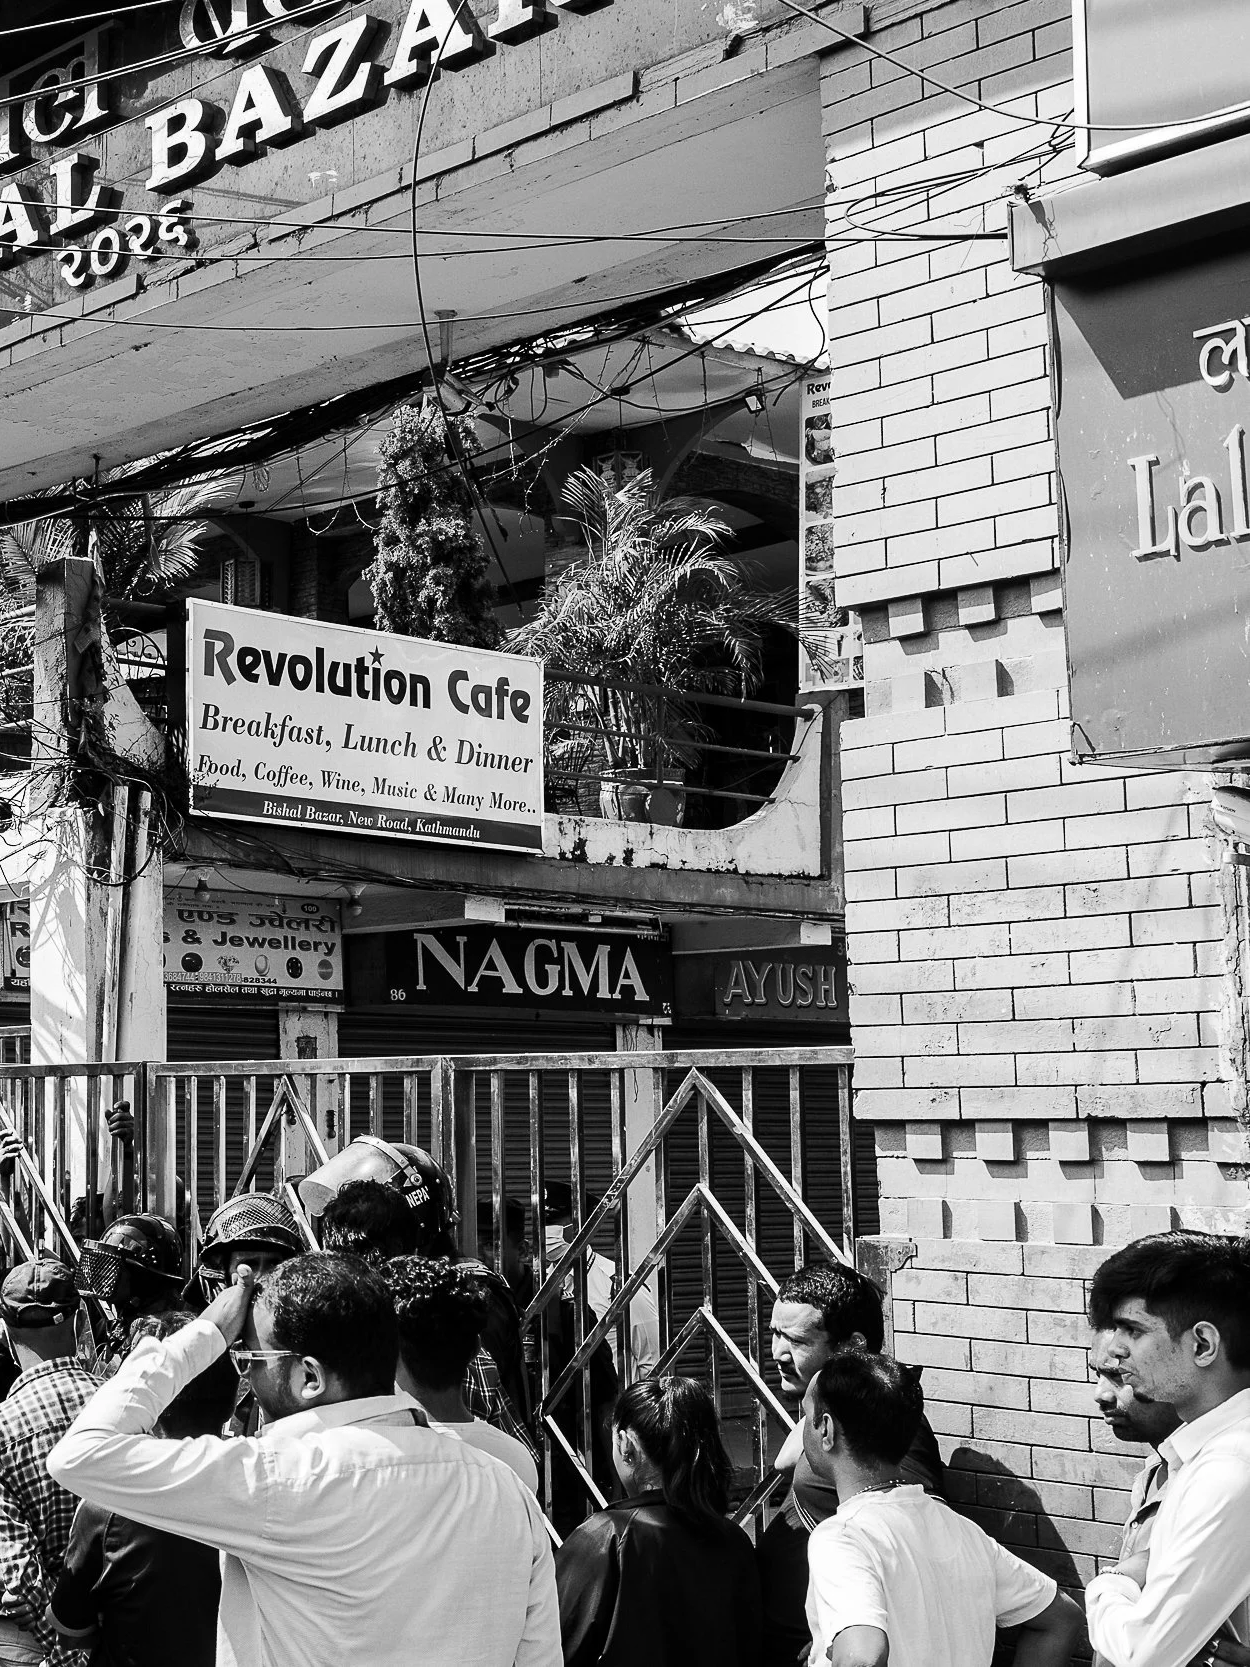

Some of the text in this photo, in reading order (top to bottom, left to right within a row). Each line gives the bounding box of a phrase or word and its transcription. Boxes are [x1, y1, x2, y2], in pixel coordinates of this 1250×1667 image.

[203, 628, 532, 724] Revolution Cafe
[199, 703, 534, 774] Breakfast, Lunch & Dinner
[197, 754, 247, 782] Food,
[254, 762, 314, 791] Coffee,
[321, 769, 366, 796] Wine,
[371, 776, 418, 799] Music
[423, 783, 438, 802] &
[442, 785, 485, 812] Many
[262, 800, 481, 839] Bishal Bazar, New Road, Kathmandu
[176, 908, 338, 934] एण्ड ज्वेलरी
[303, 905, 318, 913] 100
[181, 928, 203, 946] &
[212, 930, 337, 957] Jewellery
[413, 932, 650, 1002] NAGMA
[723, 960, 838, 1008] AYUSH
[390, 988, 406, 1001] 86
[405, 1185, 431, 1209] NEPA
